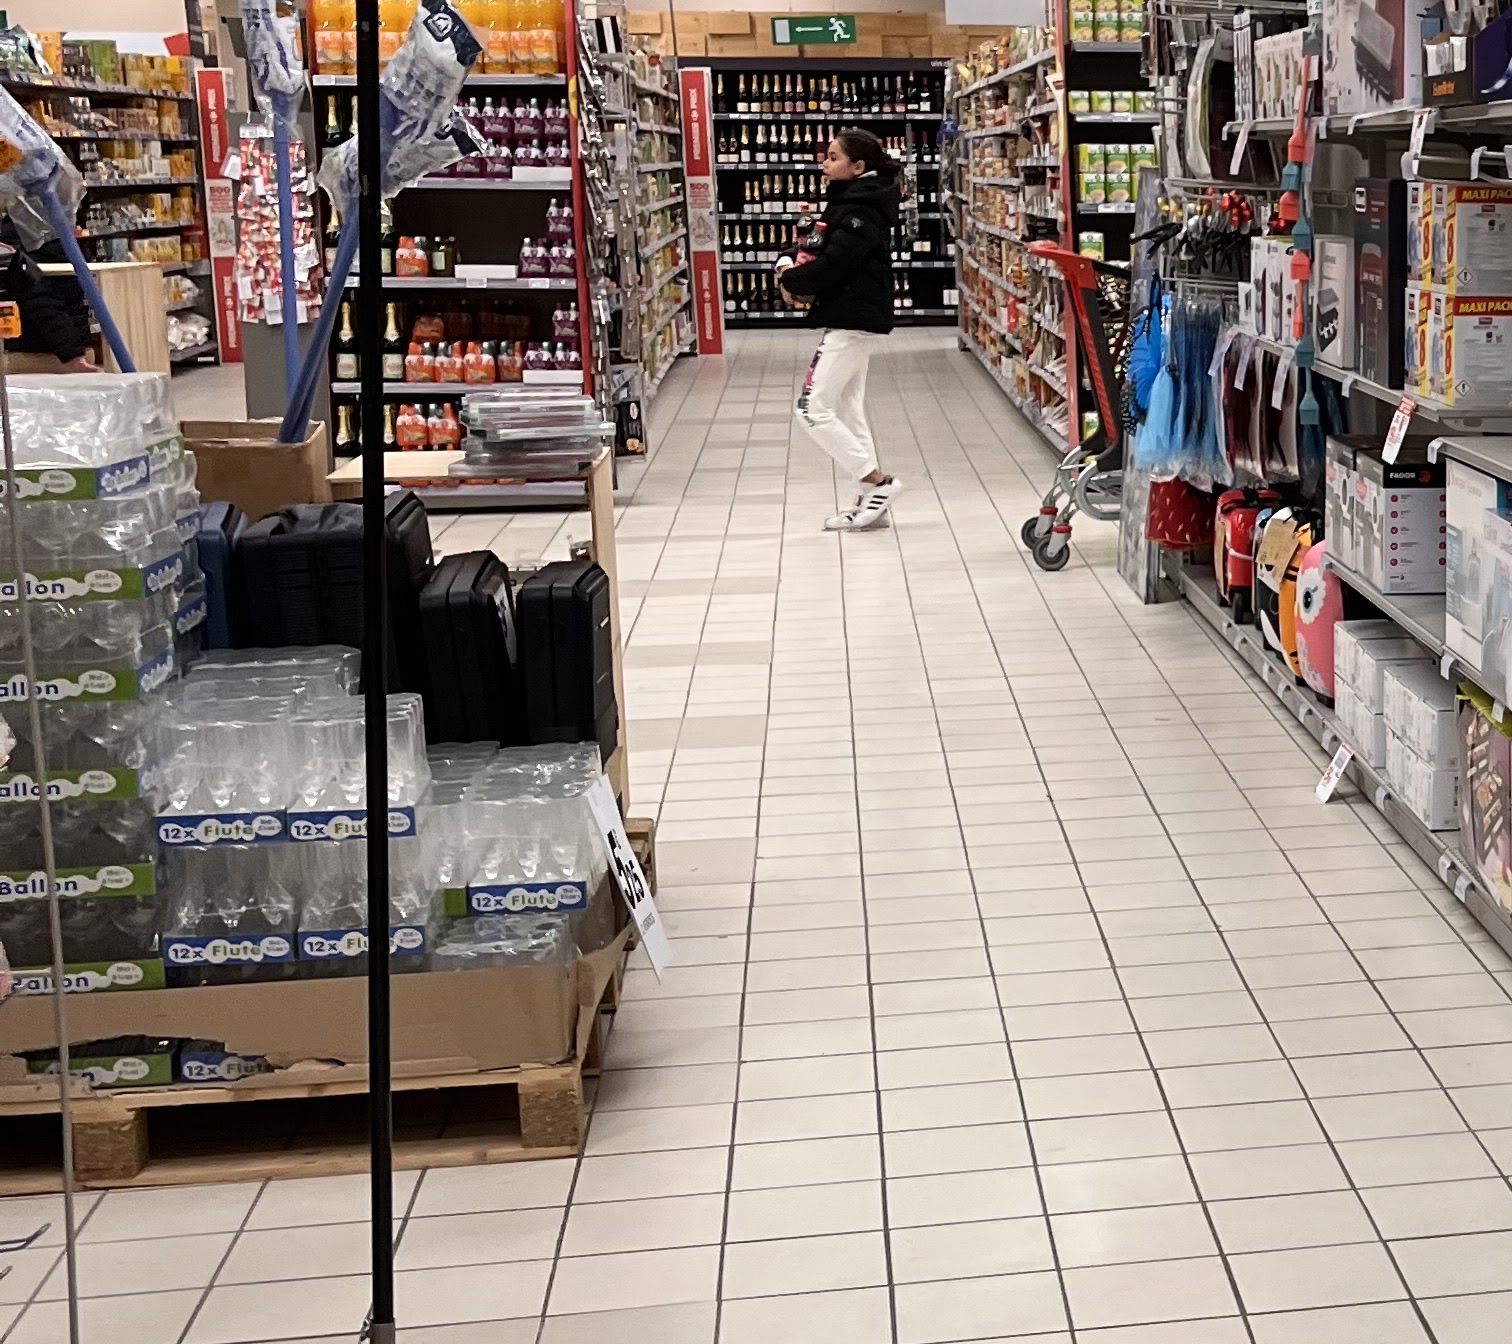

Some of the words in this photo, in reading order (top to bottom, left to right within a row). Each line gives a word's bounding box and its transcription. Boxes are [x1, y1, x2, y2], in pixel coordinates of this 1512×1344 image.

[1462, 189, 1489, 201] MAXI
[1458, 302, 1487, 313] MAXI
[203, 824, 254, 838] Flute
[511, 895, 557, 906] Flute
[212, 944, 261, 957] Flute
